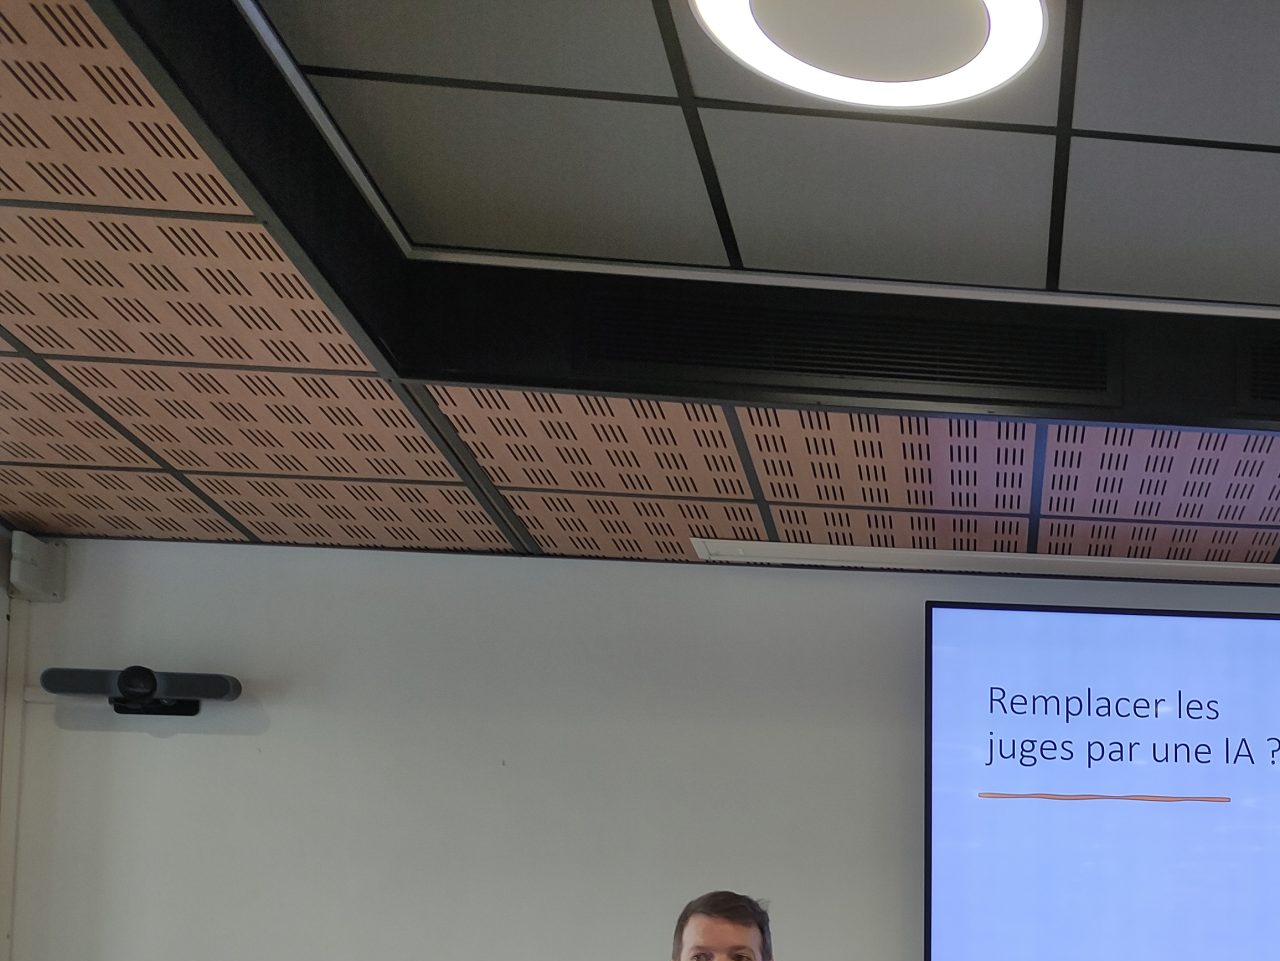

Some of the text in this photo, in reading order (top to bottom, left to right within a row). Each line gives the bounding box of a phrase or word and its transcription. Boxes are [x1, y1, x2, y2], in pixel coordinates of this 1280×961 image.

[988, 686, 1220, 723] Remplacer les
[985, 731, 1074, 767] juges
[1087, 740, 1140, 768] par
[1152, 741, 1211, 764] une
[1225, 738, 1255, 765] IA
